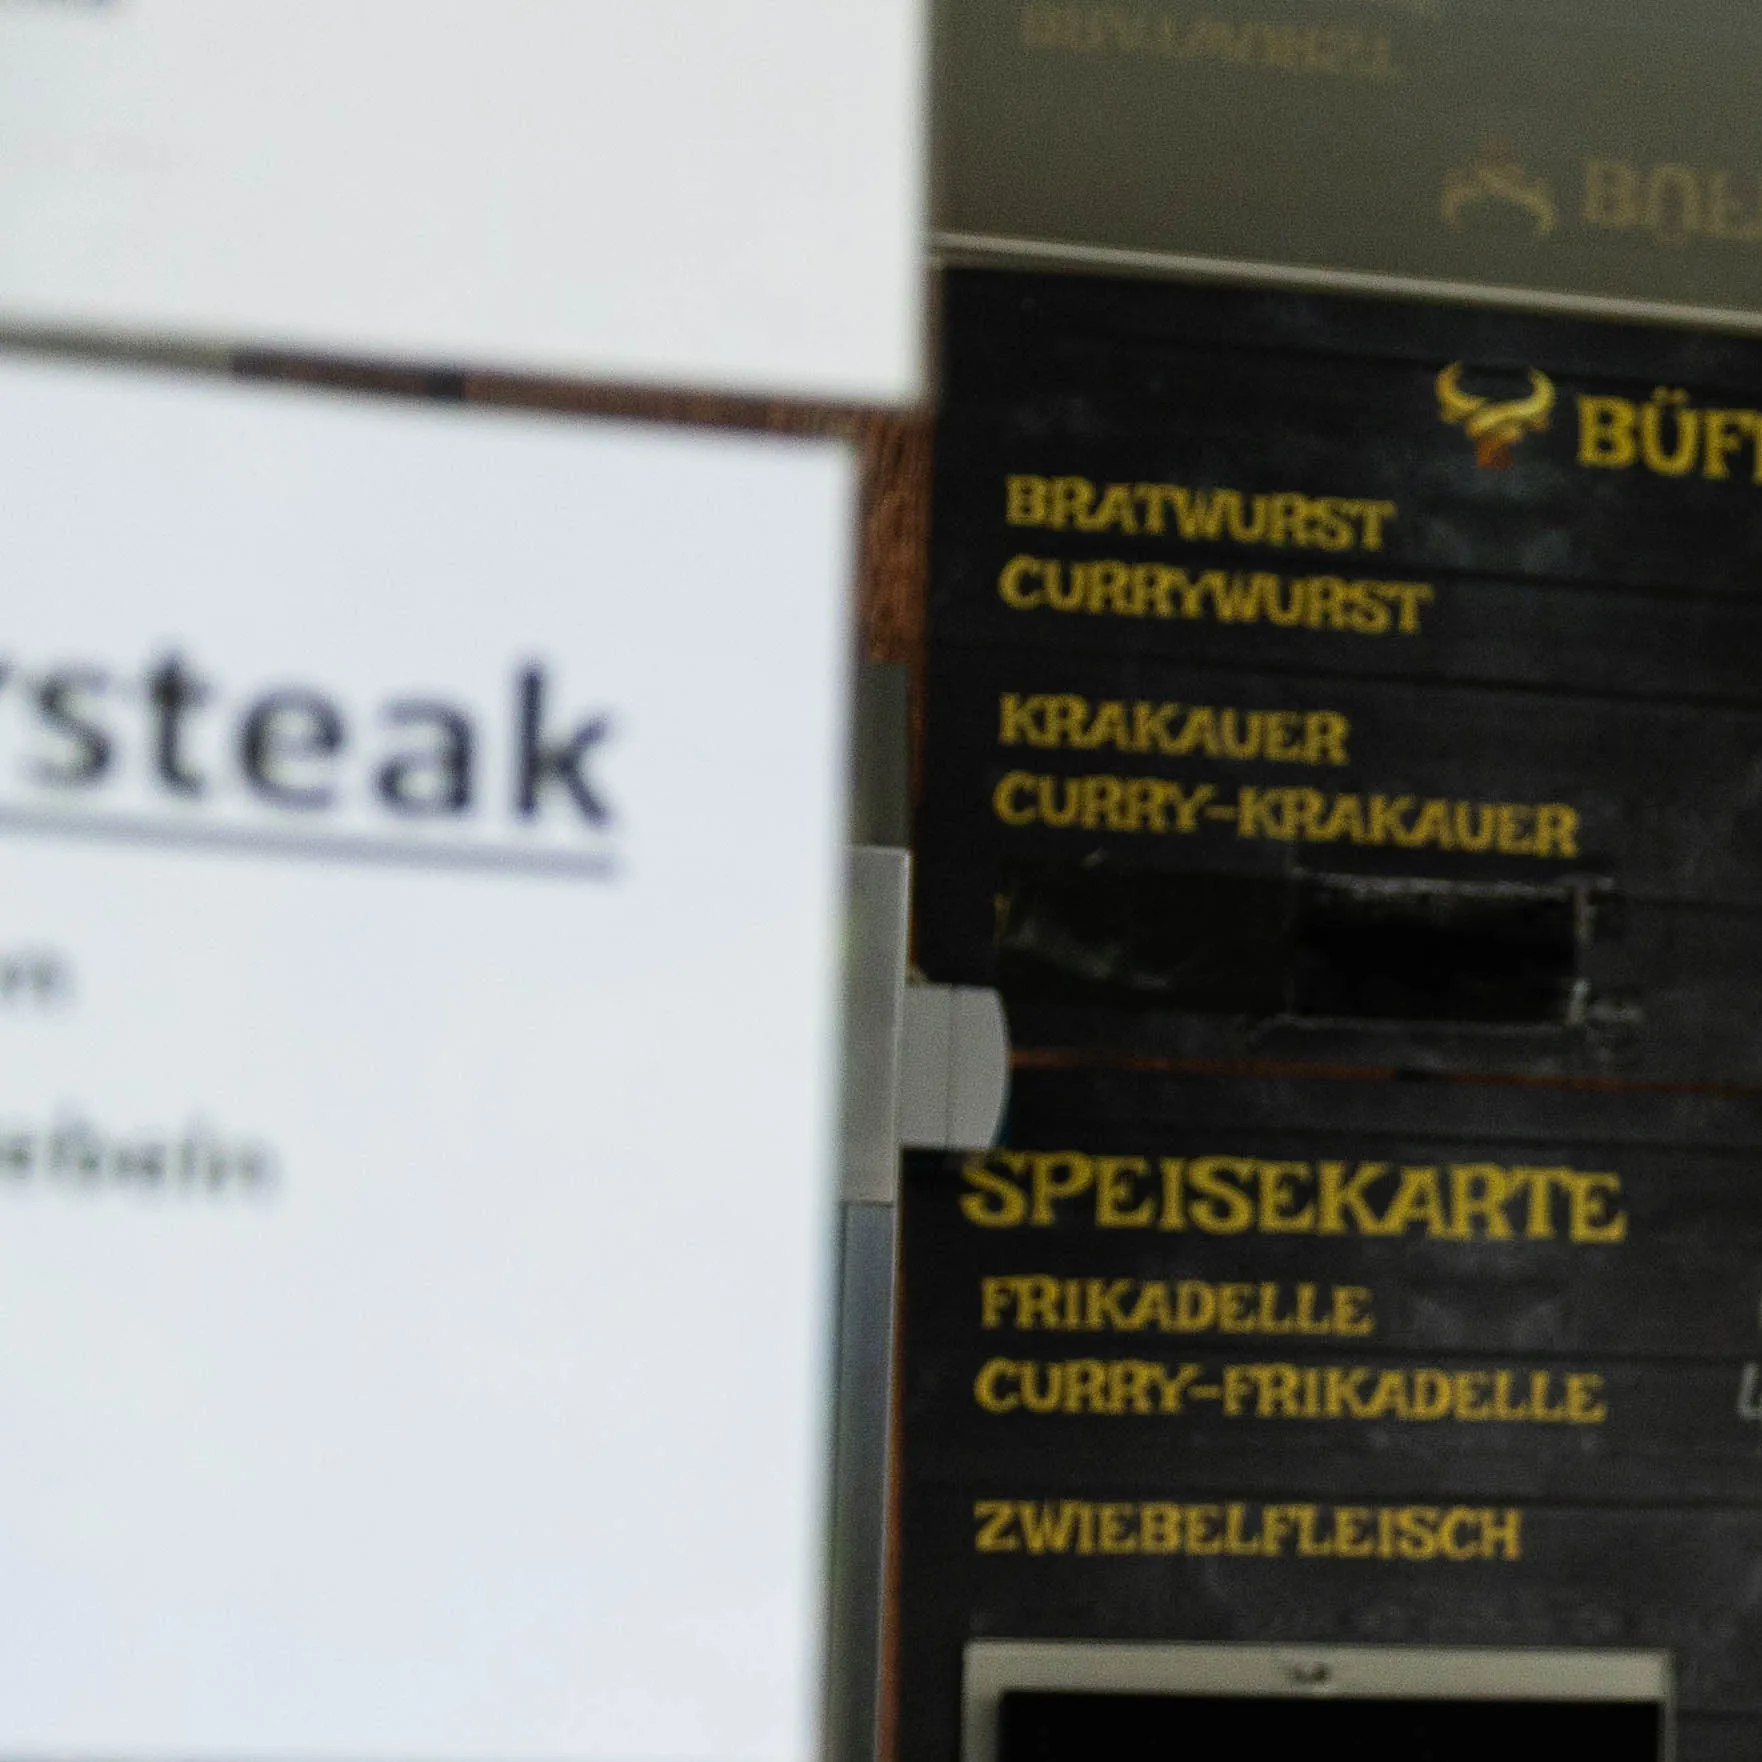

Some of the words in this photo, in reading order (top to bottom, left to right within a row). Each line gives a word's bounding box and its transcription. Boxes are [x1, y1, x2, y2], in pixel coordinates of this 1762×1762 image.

[1004, 474, 1395, 552] BRATWURST
[996, 553, 1435, 635] CURRYWURST
[0, 645, 615, 828] steak
[999, 692, 1350, 766] KRAKAUER
[992, 770, 1579, 858] CURRY-KRAKAUER
[961, 1149, 1627, 1244] SPEISEKARTE
[980, 1273, 1375, 1337] FRIKADELLE
[972, 1355, 1607, 1424] CURRY-FRIKADELLE
[972, 1499, 1523, 1562] ZWIEBELFLEISCH
